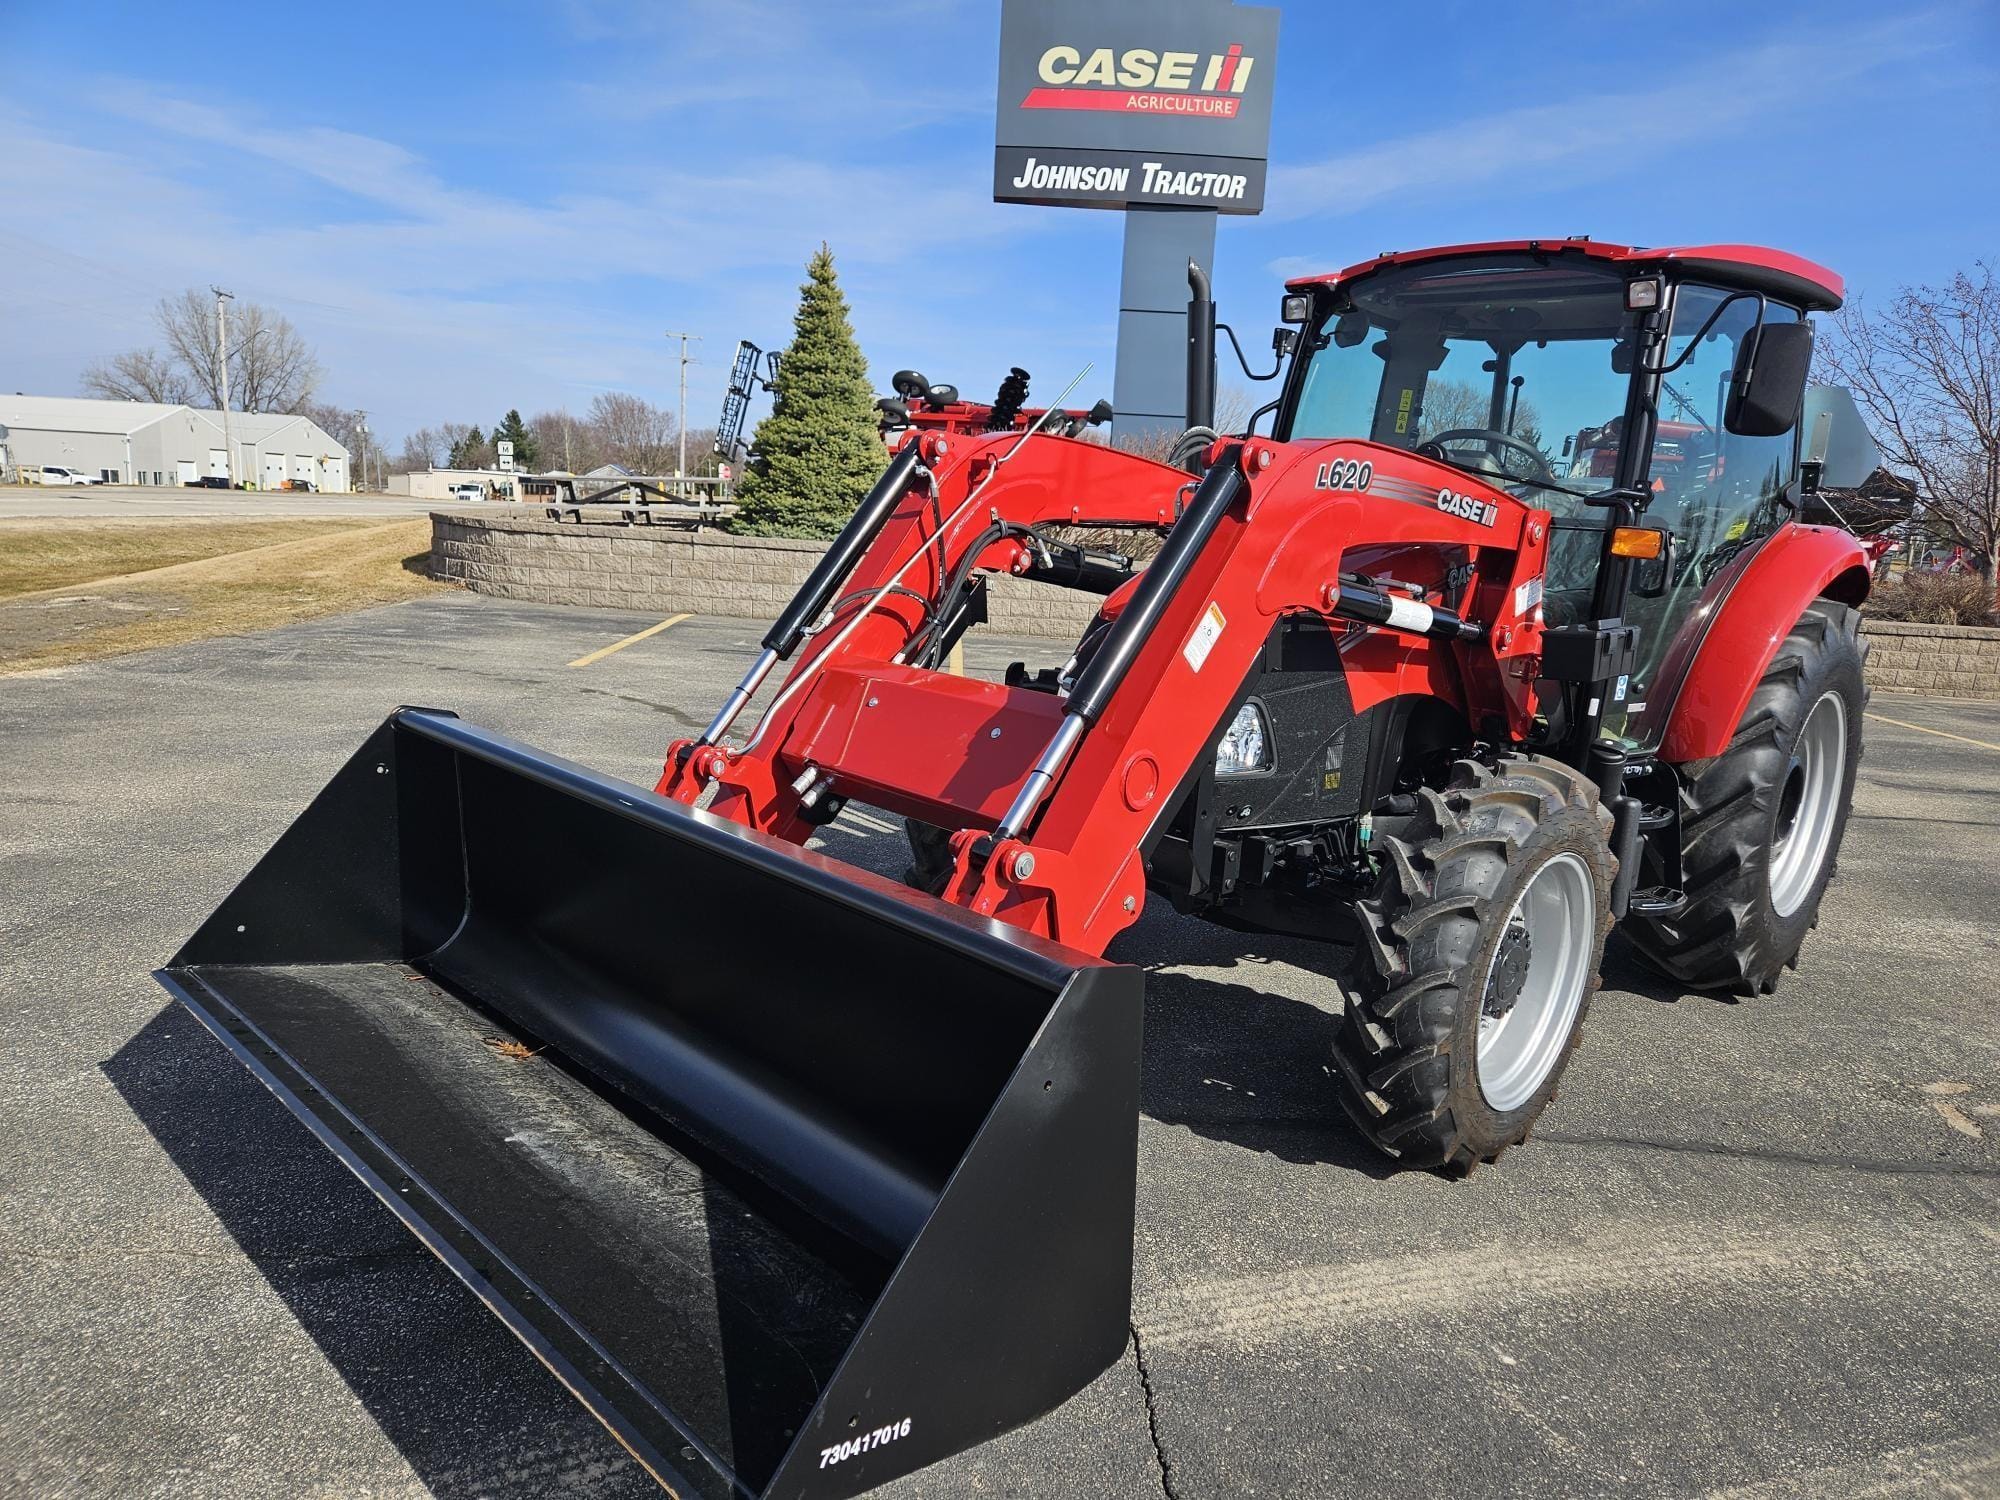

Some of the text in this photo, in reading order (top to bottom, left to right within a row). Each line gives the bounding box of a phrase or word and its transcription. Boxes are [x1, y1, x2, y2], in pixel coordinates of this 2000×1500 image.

[1038, 45, 1199, 90] CASE
[1125, 95, 1233, 115] AGRICULTURE
[1013, 157, 1247, 199] JOHNSON TRACTOR
[1315, 457, 1373, 493] L620
[1437, 487, 1481, 523] CASE
[818, 1417, 912, 1469] 730417016
